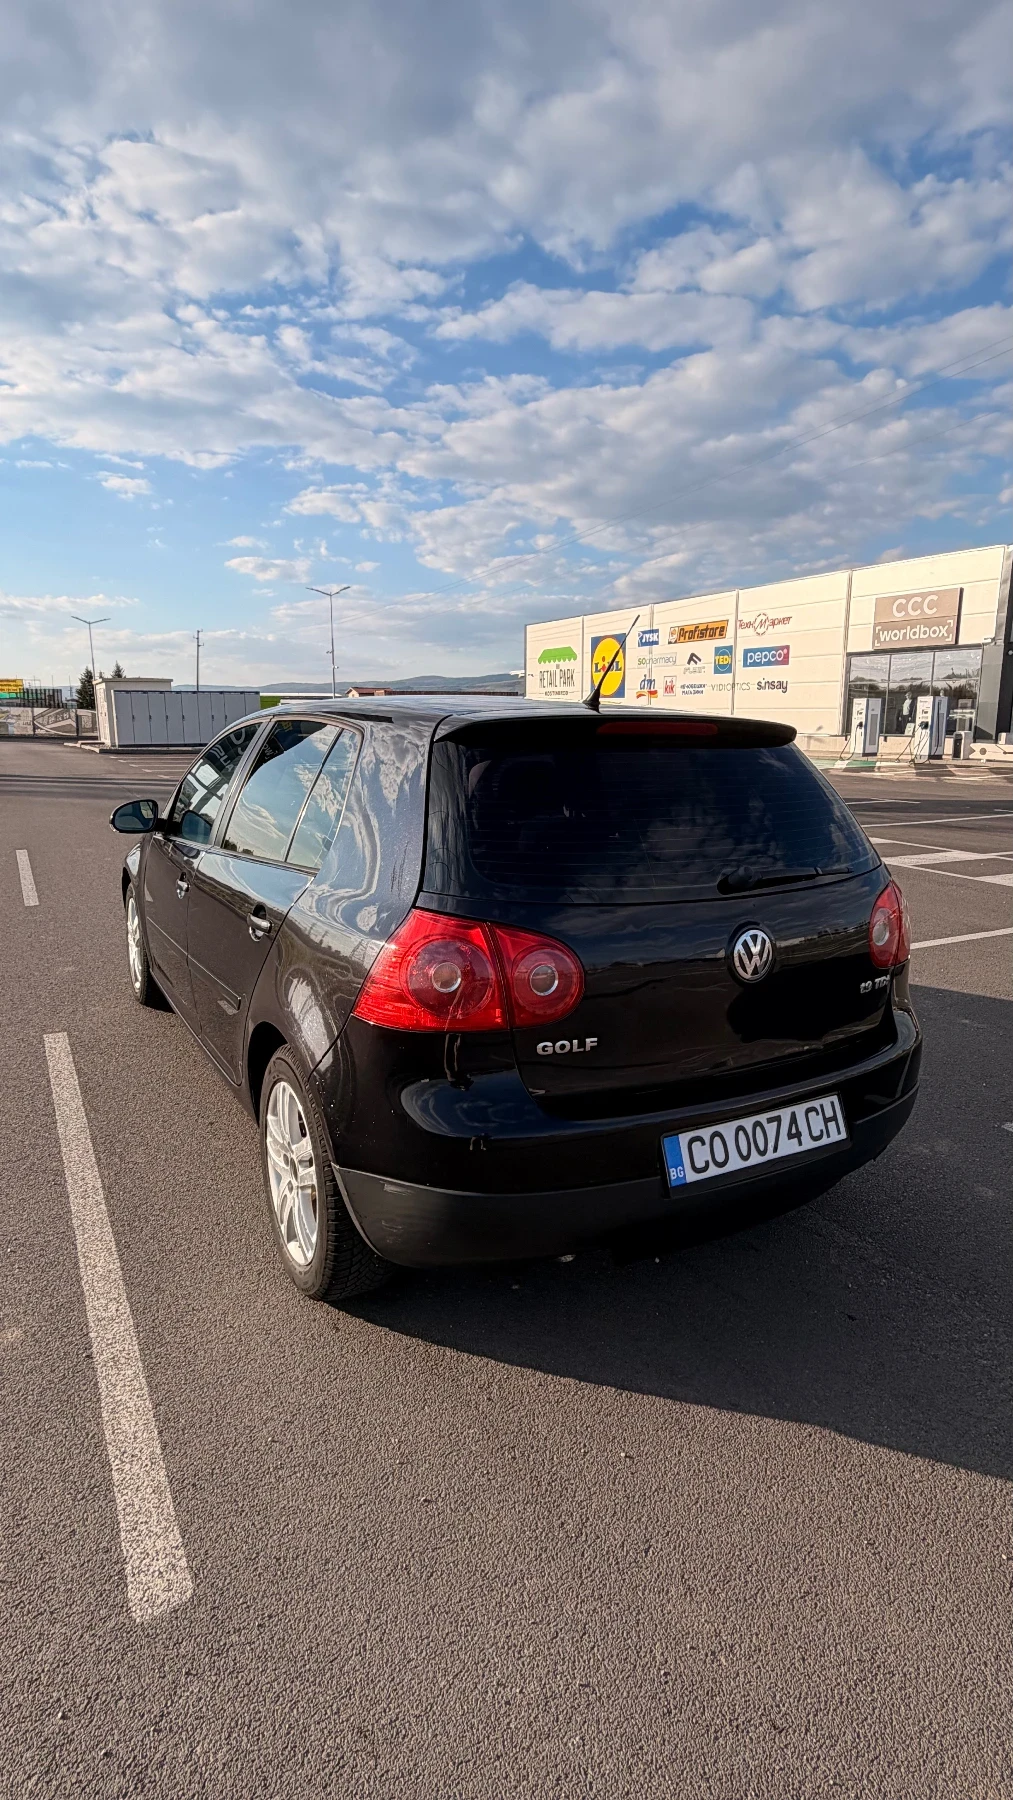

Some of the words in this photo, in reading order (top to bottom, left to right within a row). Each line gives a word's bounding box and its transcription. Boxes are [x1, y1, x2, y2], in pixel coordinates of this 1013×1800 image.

[892, 594, 939, 618] CCC
[642, 632, 659, 643] JYSK
[678, 625, 725, 641] Profistore
[879, 623, 949, 642] worldbox
[747, 650, 784, 666] pepco
[539, 670, 558, 688] RETAIL
[559, 668, 576, 687] PARK
[640, 674, 656, 690] dm
[756, 677, 788, 693] sinsay
[536, 1037, 599, 1056] GOLF
[669, 1166, 685, 1181] BG
[734, 1110, 803, 1162] 0074
[804, 1099, 842, 1142] CH
